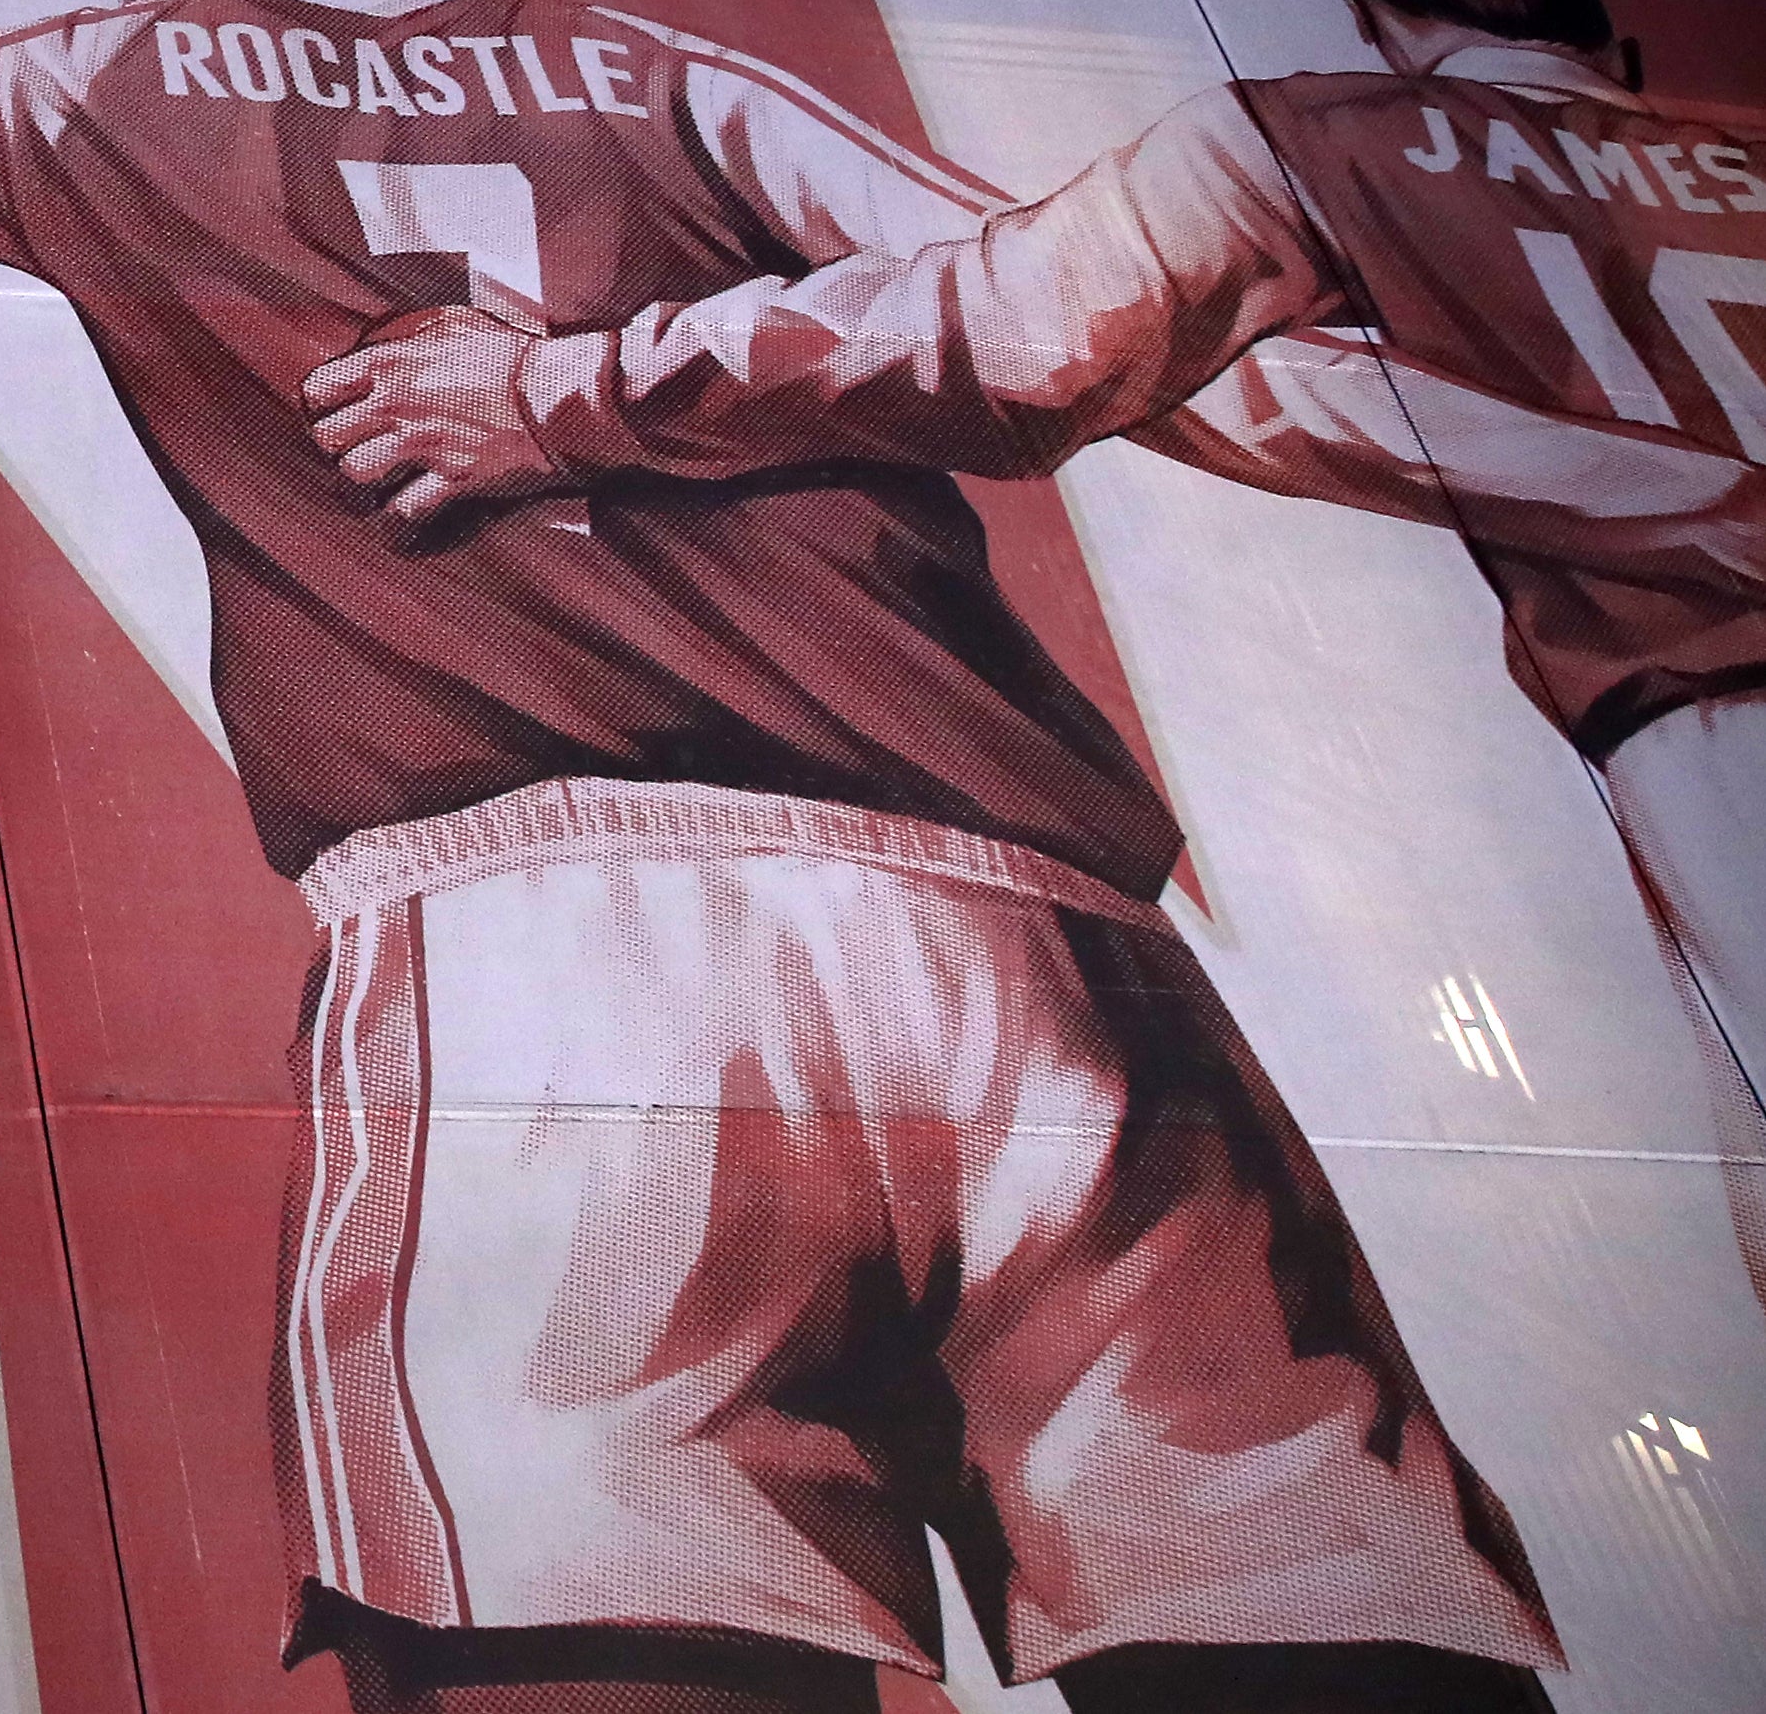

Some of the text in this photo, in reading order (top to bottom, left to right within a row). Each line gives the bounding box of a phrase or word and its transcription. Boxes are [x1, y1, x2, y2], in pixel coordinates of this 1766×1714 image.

[154, 19, 649, 119] ROCASTLE
[1403, 107, 1766, 214] JAMES
[336, 159, 546, 336] 7
